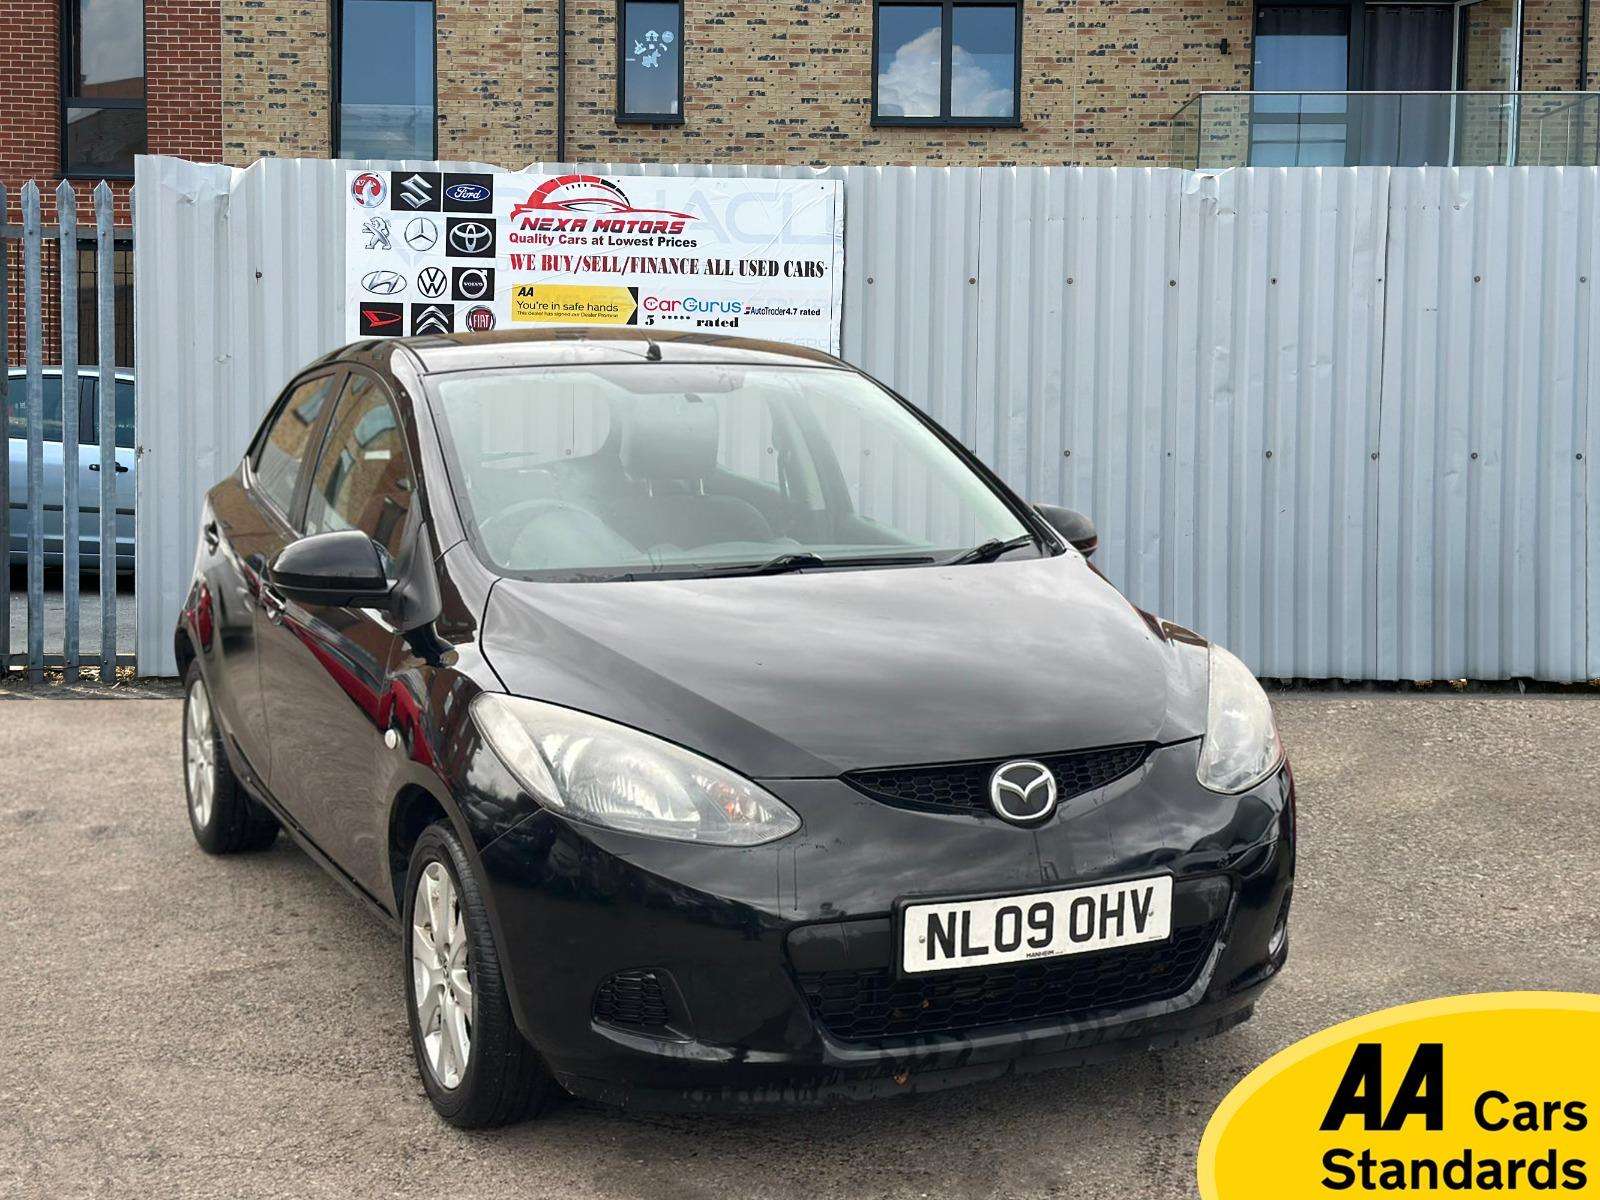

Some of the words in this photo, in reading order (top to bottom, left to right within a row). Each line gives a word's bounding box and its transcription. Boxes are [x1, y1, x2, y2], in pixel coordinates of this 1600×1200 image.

[454, 187, 481, 199] Ford
[520, 217, 588, 232] NEXA
[592, 219, 686, 234] MOTORS
[509, 233, 555, 246] Quality
[558, 234, 588, 245] Cars
[591, 235, 604, 245] at
[608, 235, 654, 247] Lowest
[657, 237, 697, 248] Prices
[510, 254, 536, 271] WE
[541, 254, 699, 276] BUY/SELL/FINANCE
[704, 258, 734, 276] ALL
[739, 259, 779, 277] USED
[518, 286, 534, 297] AA
[516, 300, 549, 310] You're
[551, 302, 560, 310] in
[563, 302, 585, 311] safe
[587, 302, 619, 312] hands
[643, 297, 742, 313] CarGurus
[799, 308, 821, 316] rated
[473, 314, 490, 327] FIAT
[645, 315, 655, 326] 5
[696, 317, 739, 328] rated
[927, 901, 1054, 961] NL09
[1069, 886, 1154, 944] OHV
